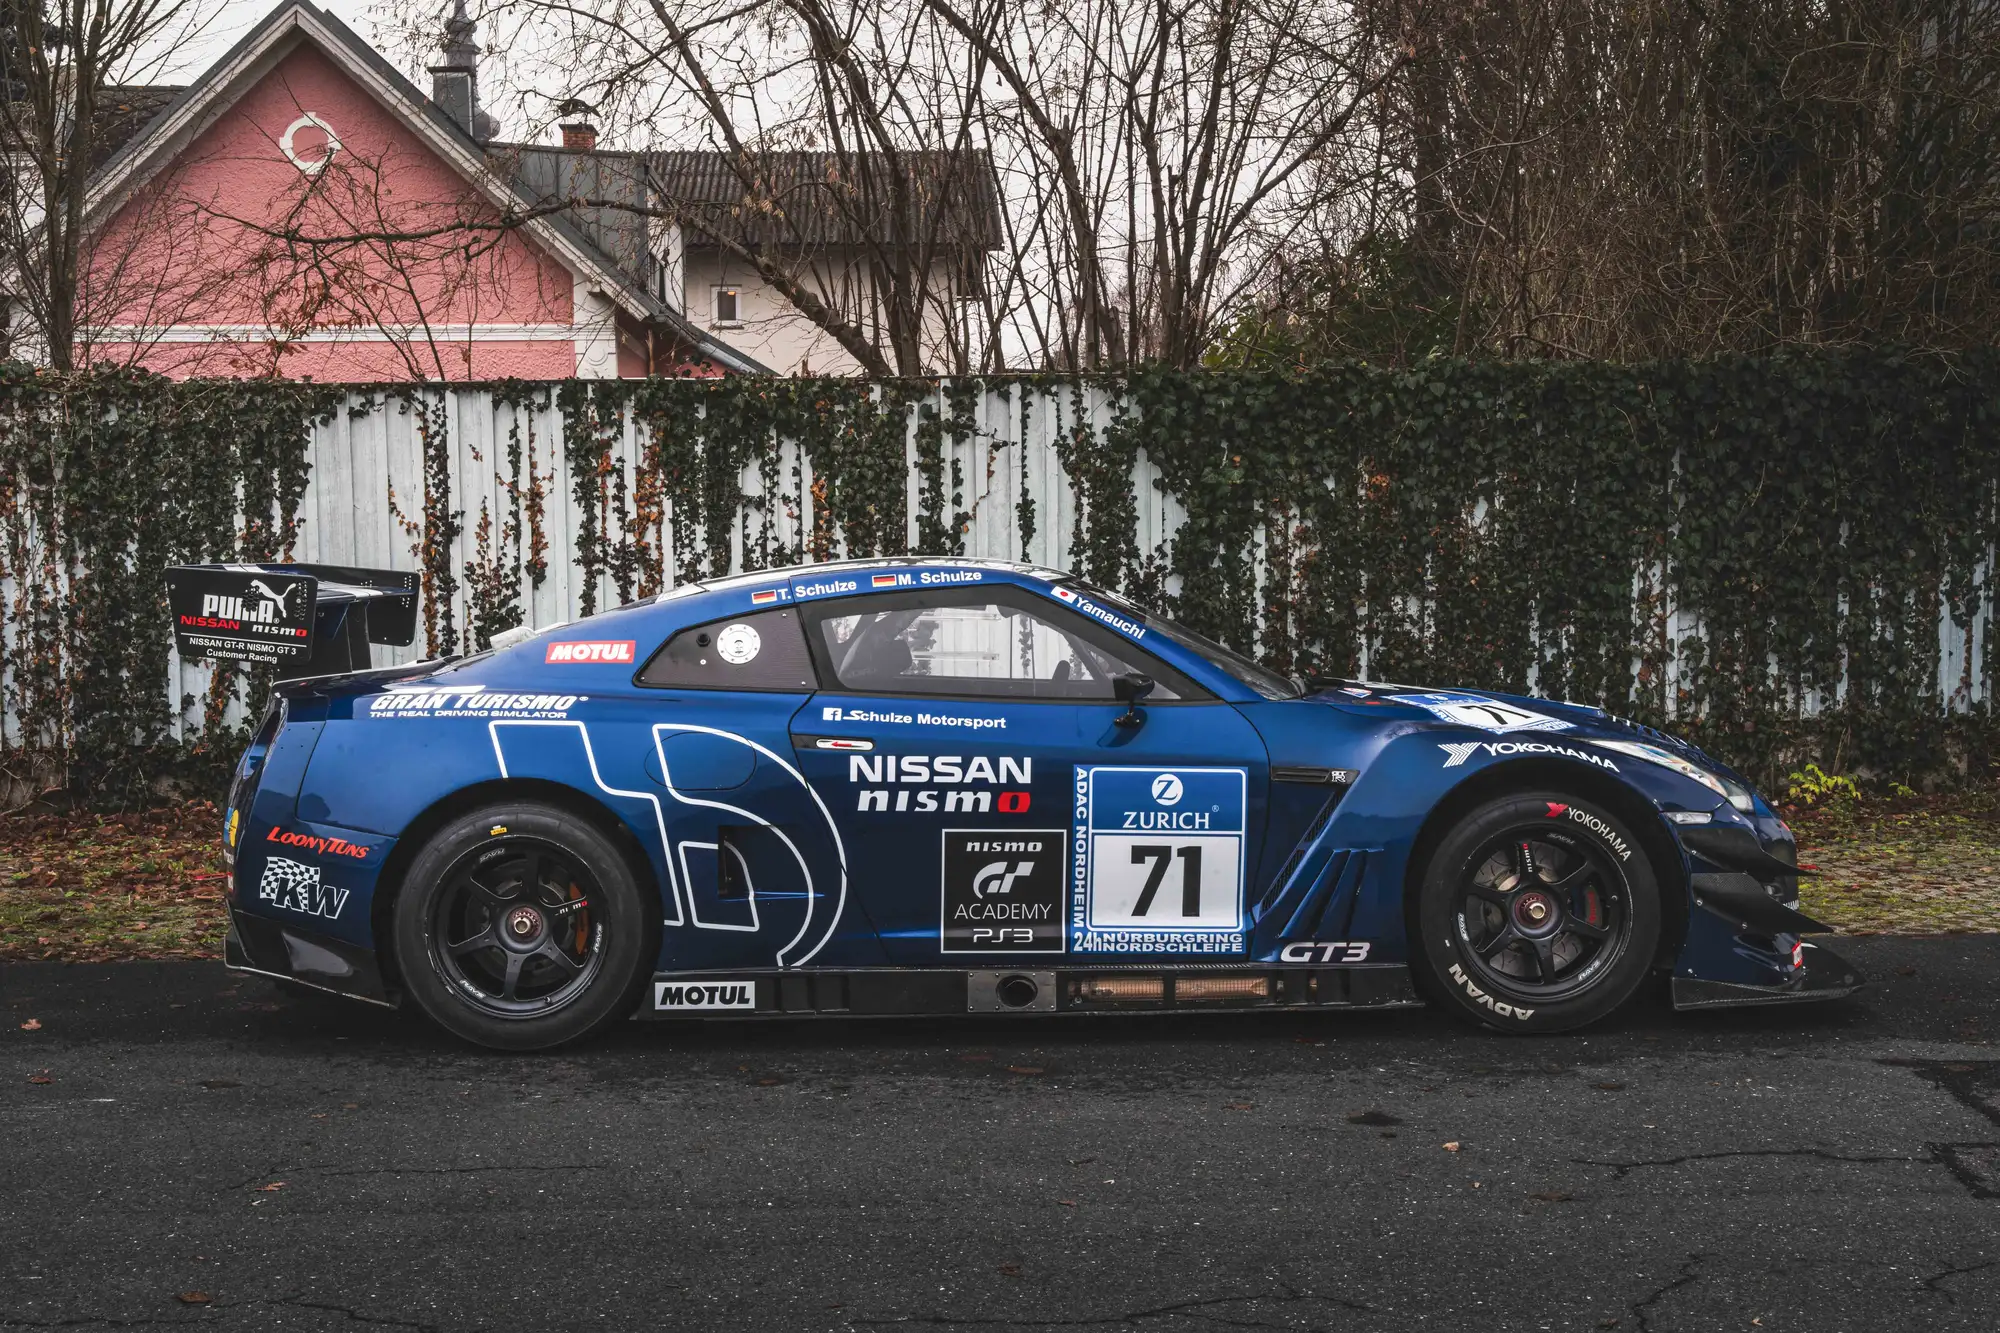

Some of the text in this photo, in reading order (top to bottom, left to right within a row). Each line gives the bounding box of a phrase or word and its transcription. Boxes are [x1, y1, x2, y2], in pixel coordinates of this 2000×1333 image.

[899, 571, 982, 585] M. Schulze
[778, 580, 857, 600] T. Schulze
[180, 615, 240, 630] NISSAN
[1075, 596, 1146, 640] Yamauchi
[252, 624, 307, 637] nismo
[189, 637, 297, 656] NISSAN GT-R NISMO GT 3
[206, 648, 278, 664] Customer Racing
[550, 644, 631, 661] MOTUL
[370, 694, 578, 712] GRAN TURISMO
[434, 710, 488, 718] DRIVING
[490, 711, 567, 720] SIMULATOR
[843, 710, 913, 724] Schulze
[917, 713, 1007, 730] Motorsport
[1482, 742, 1621, 774] YOKOHAMA
[850, 755, 1032, 784] NISSAN
[857, 790, 1032, 814] nismo
[1076, 767, 1088, 820] ADAC
[1122, 811, 1210, 829] ZURICH
[1567, 807, 1633, 862] YOKOHAMA
[966, 842, 1043, 852] nismo
[1130, 844, 1202, 918] 71
[272, 876, 350, 919] KW
[954, 903, 1052, 920] ACADEMY
[973, 928, 1034, 943] PS3
[1073, 932, 1243, 952] 24h NÜRBURGRING
[1103, 943, 1243, 952] NORDSCHLEIFE
[1280, 942, 1371, 963] GT3
[660, 986, 750, 1006] MOTUL
[1448, 963, 1535, 1021] ADVAN
